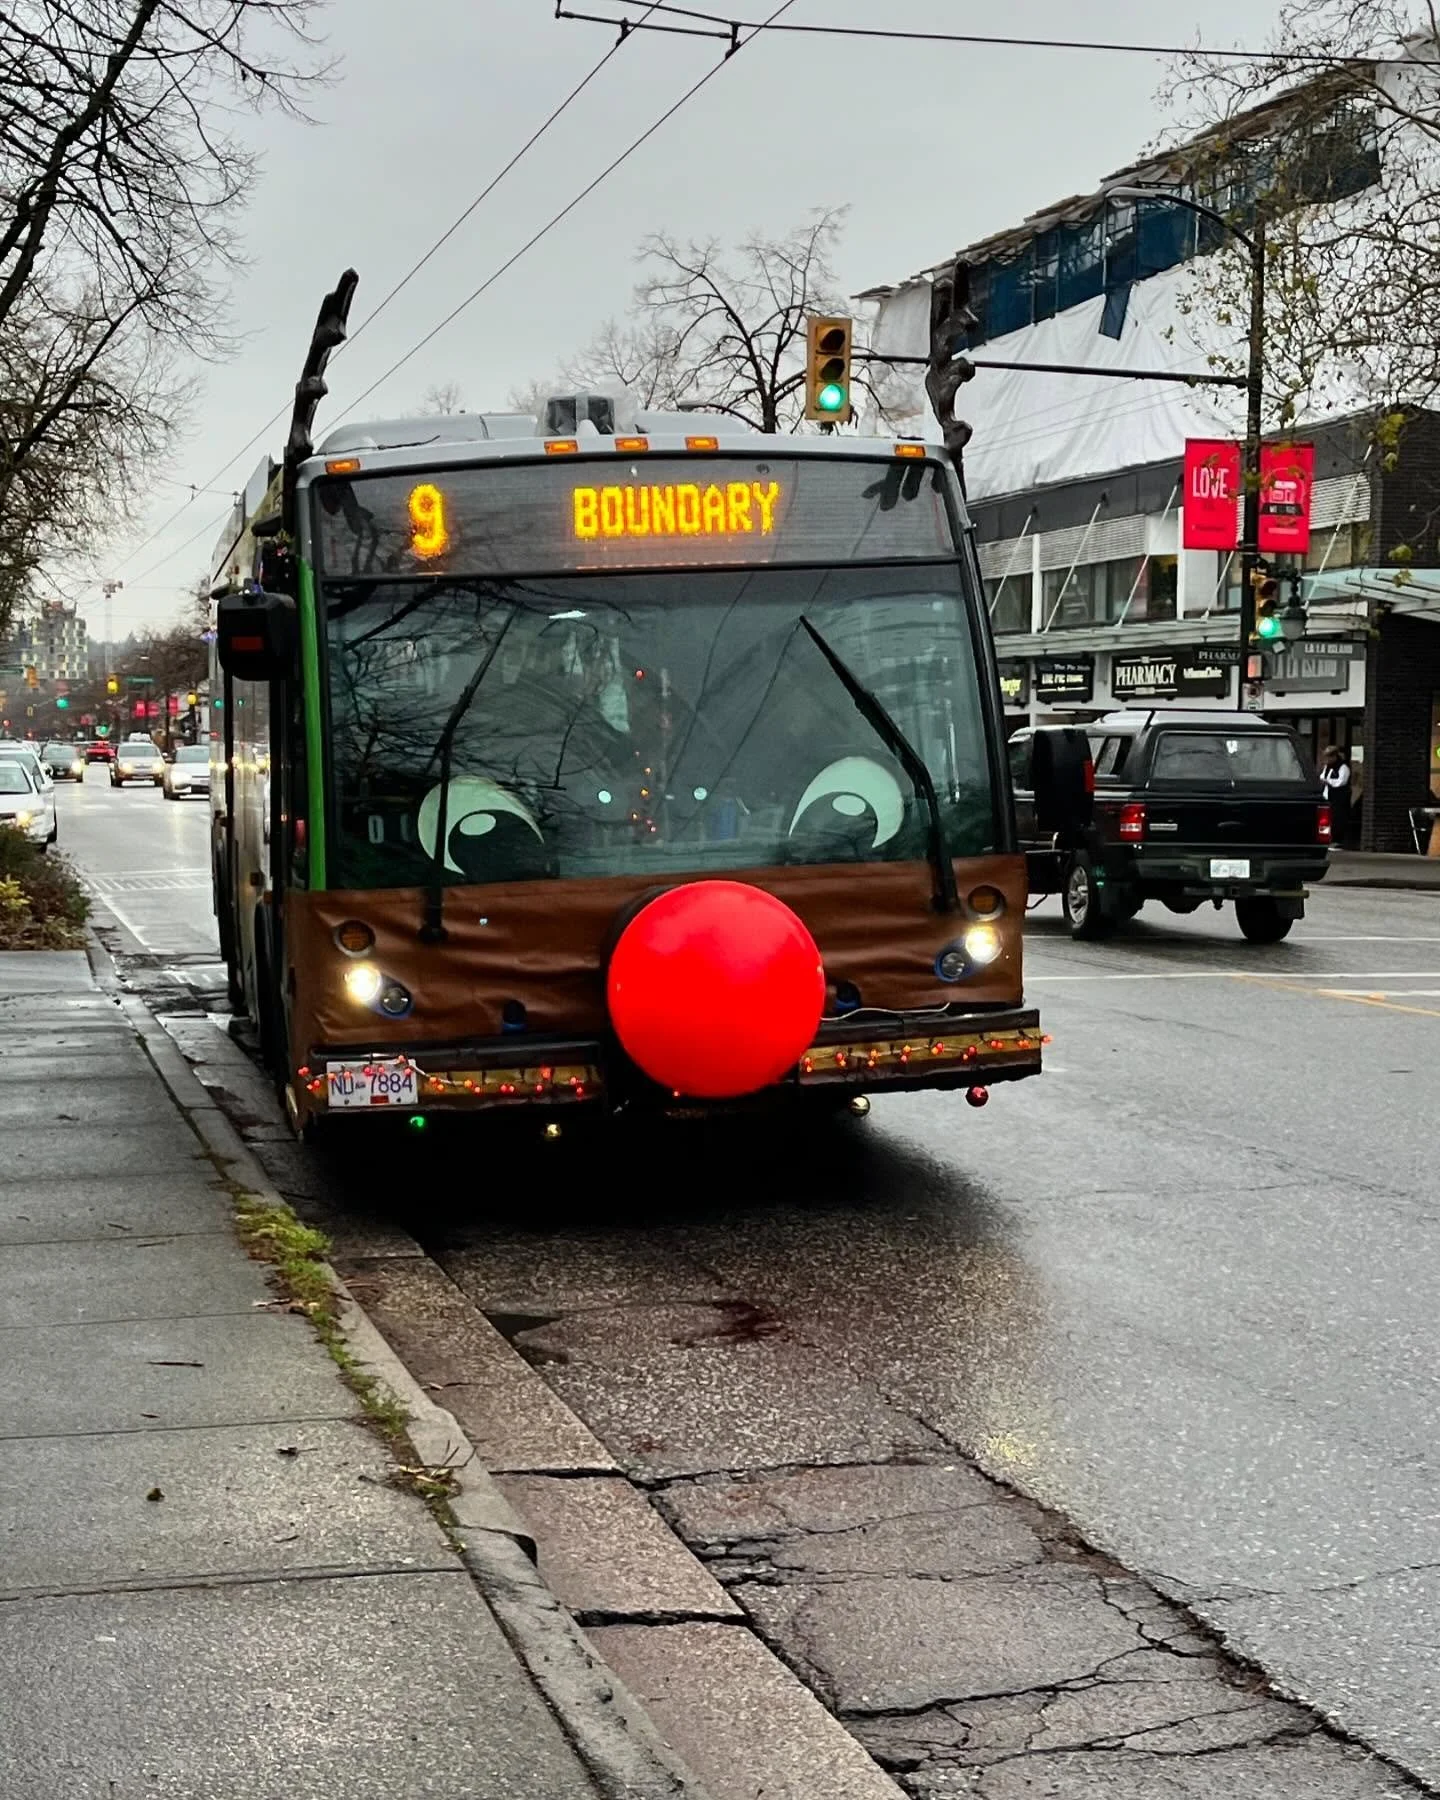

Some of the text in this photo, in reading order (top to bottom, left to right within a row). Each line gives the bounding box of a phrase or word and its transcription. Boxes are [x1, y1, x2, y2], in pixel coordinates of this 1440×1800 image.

[1192, 466, 1229, 499] LOVE
[408, 481, 779, 558] 9 BOUNDARY
[1115, 664, 1177, 686] PHARMACY
[369, 1073, 412, 1093] 7884
